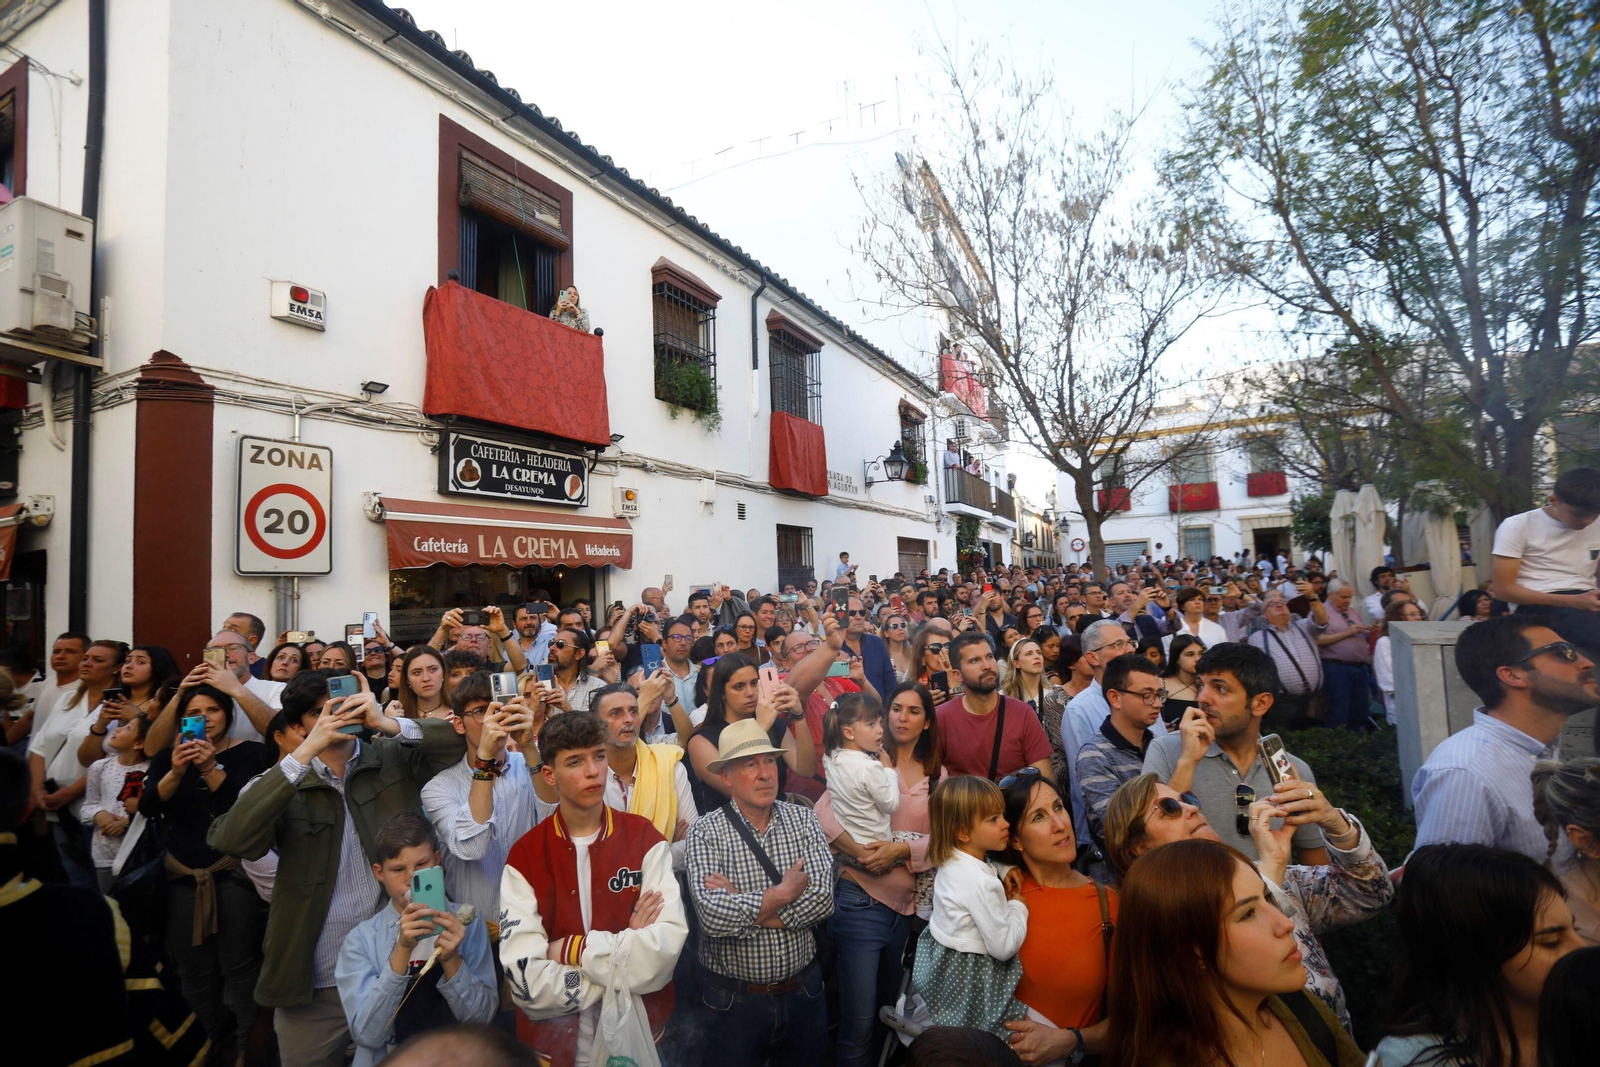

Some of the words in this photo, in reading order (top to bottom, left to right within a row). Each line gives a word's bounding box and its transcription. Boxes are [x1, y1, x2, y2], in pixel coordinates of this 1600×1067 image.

[290, 303, 323, 320] EMSA
[250, 444, 323, 471] ZONA
[470, 443, 520, 464] CAFETERIA
[526, 453, 572, 472] HELADERIA
[491, 464, 510, 480] LA
[512, 467, 557, 486] CREMA
[504, 483, 545, 495] DESAYUNOS
[621, 503, 638, 511] EMSA
[263, 508, 310, 535] 20
[413, 536, 468, 554] Cafetería
[478, 534, 508, 559] LA
[513, 535, 580, 560] CREMA
[585, 543, 621, 557] Heladería
